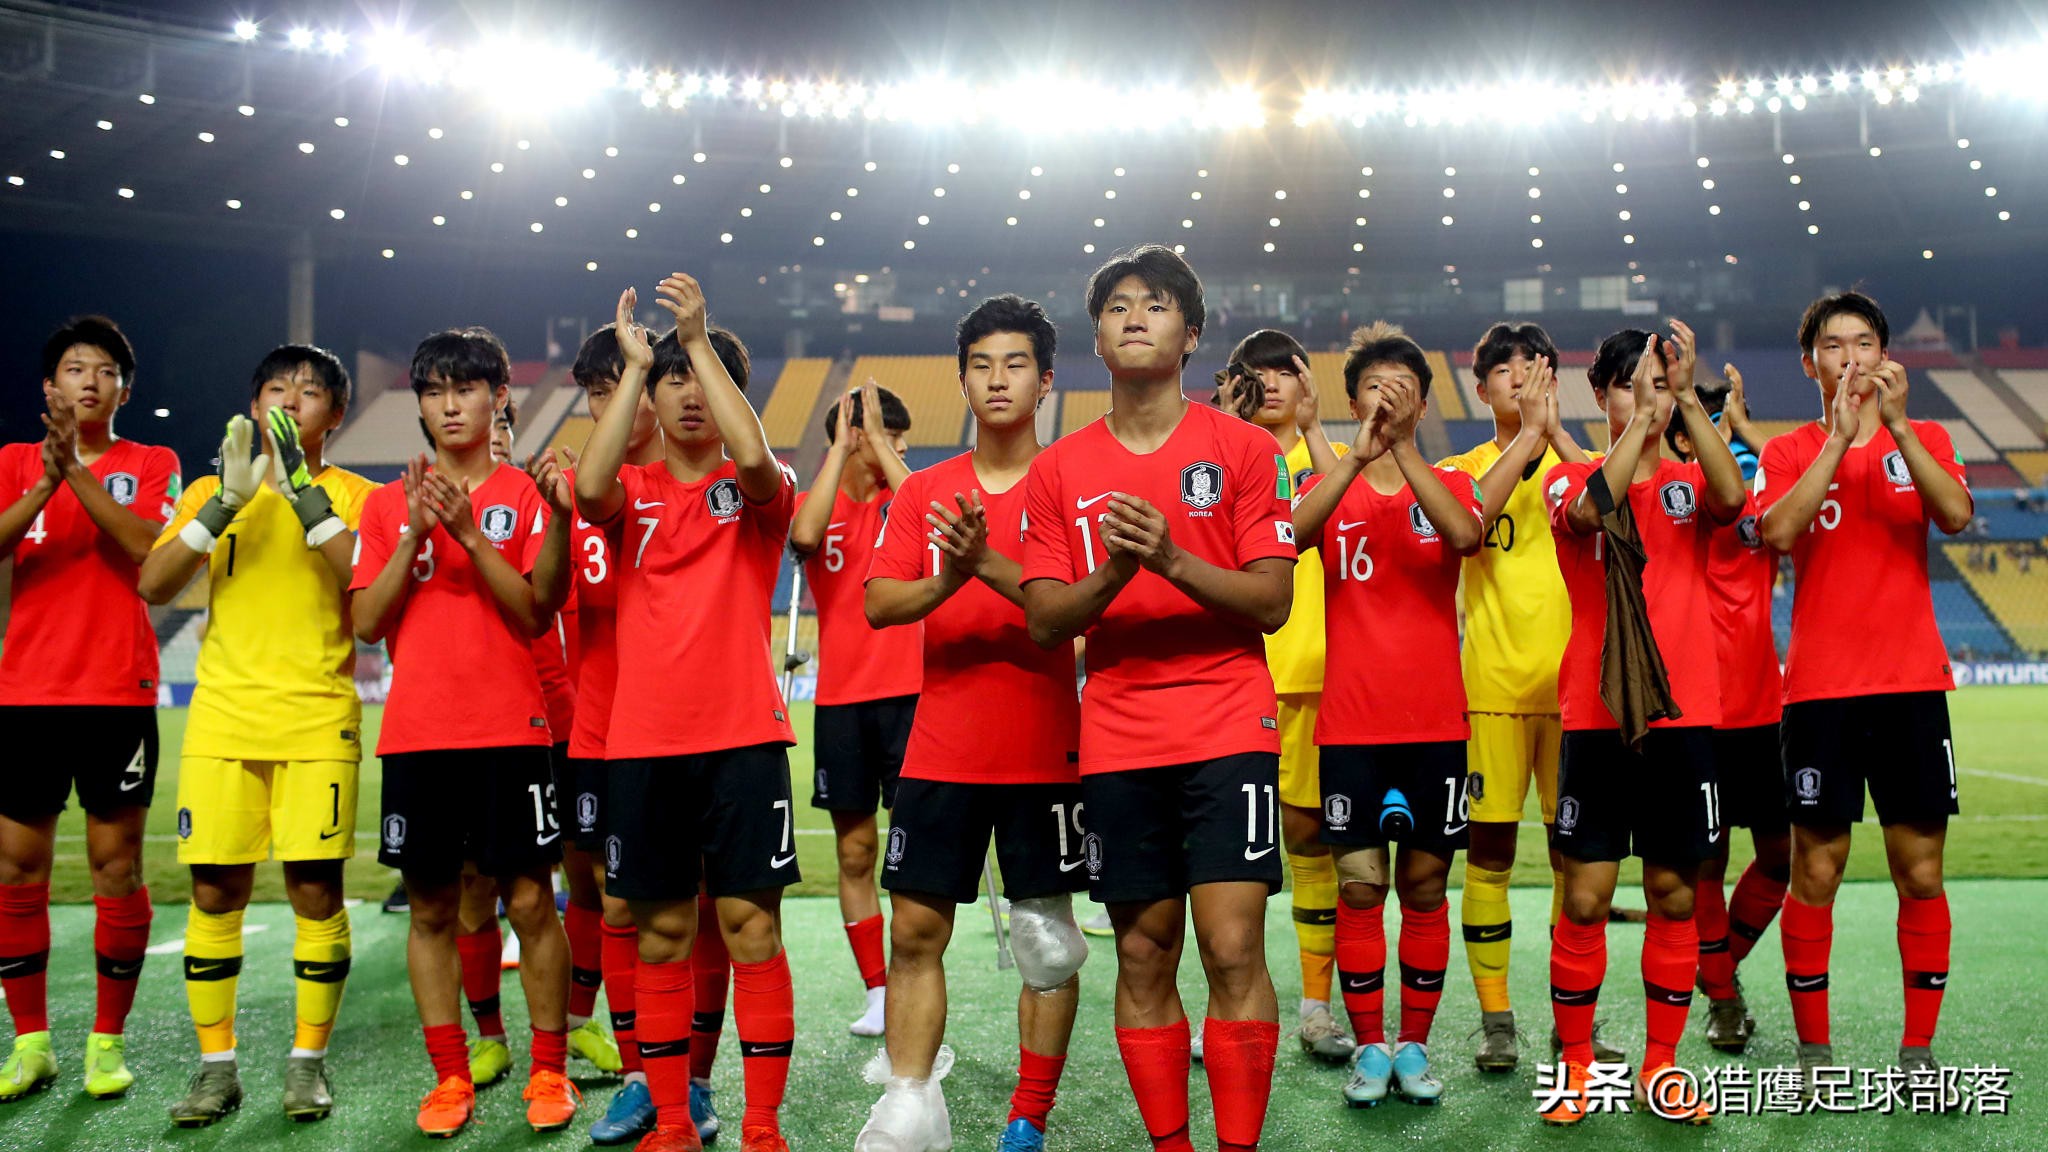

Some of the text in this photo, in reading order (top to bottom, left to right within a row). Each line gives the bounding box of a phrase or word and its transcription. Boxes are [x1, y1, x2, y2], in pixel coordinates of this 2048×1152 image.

[24, 510, 48, 544] 4
[635, 517, 660, 568] 7
[1484, 513, 1515, 552] 20
[226, 533, 237, 577] 1
[583, 535, 607, 584] 3
[825, 535, 844, 573] 5
[1336, 536, 1374, 581] 16
[126, 738, 146, 779] 4
[329, 783, 340, 827] 1
[528, 784, 560, 831] 13
[1241, 783, 1274, 843] 11
[1444, 777, 1469, 823] 16
[773, 800, 789, 852] 7
